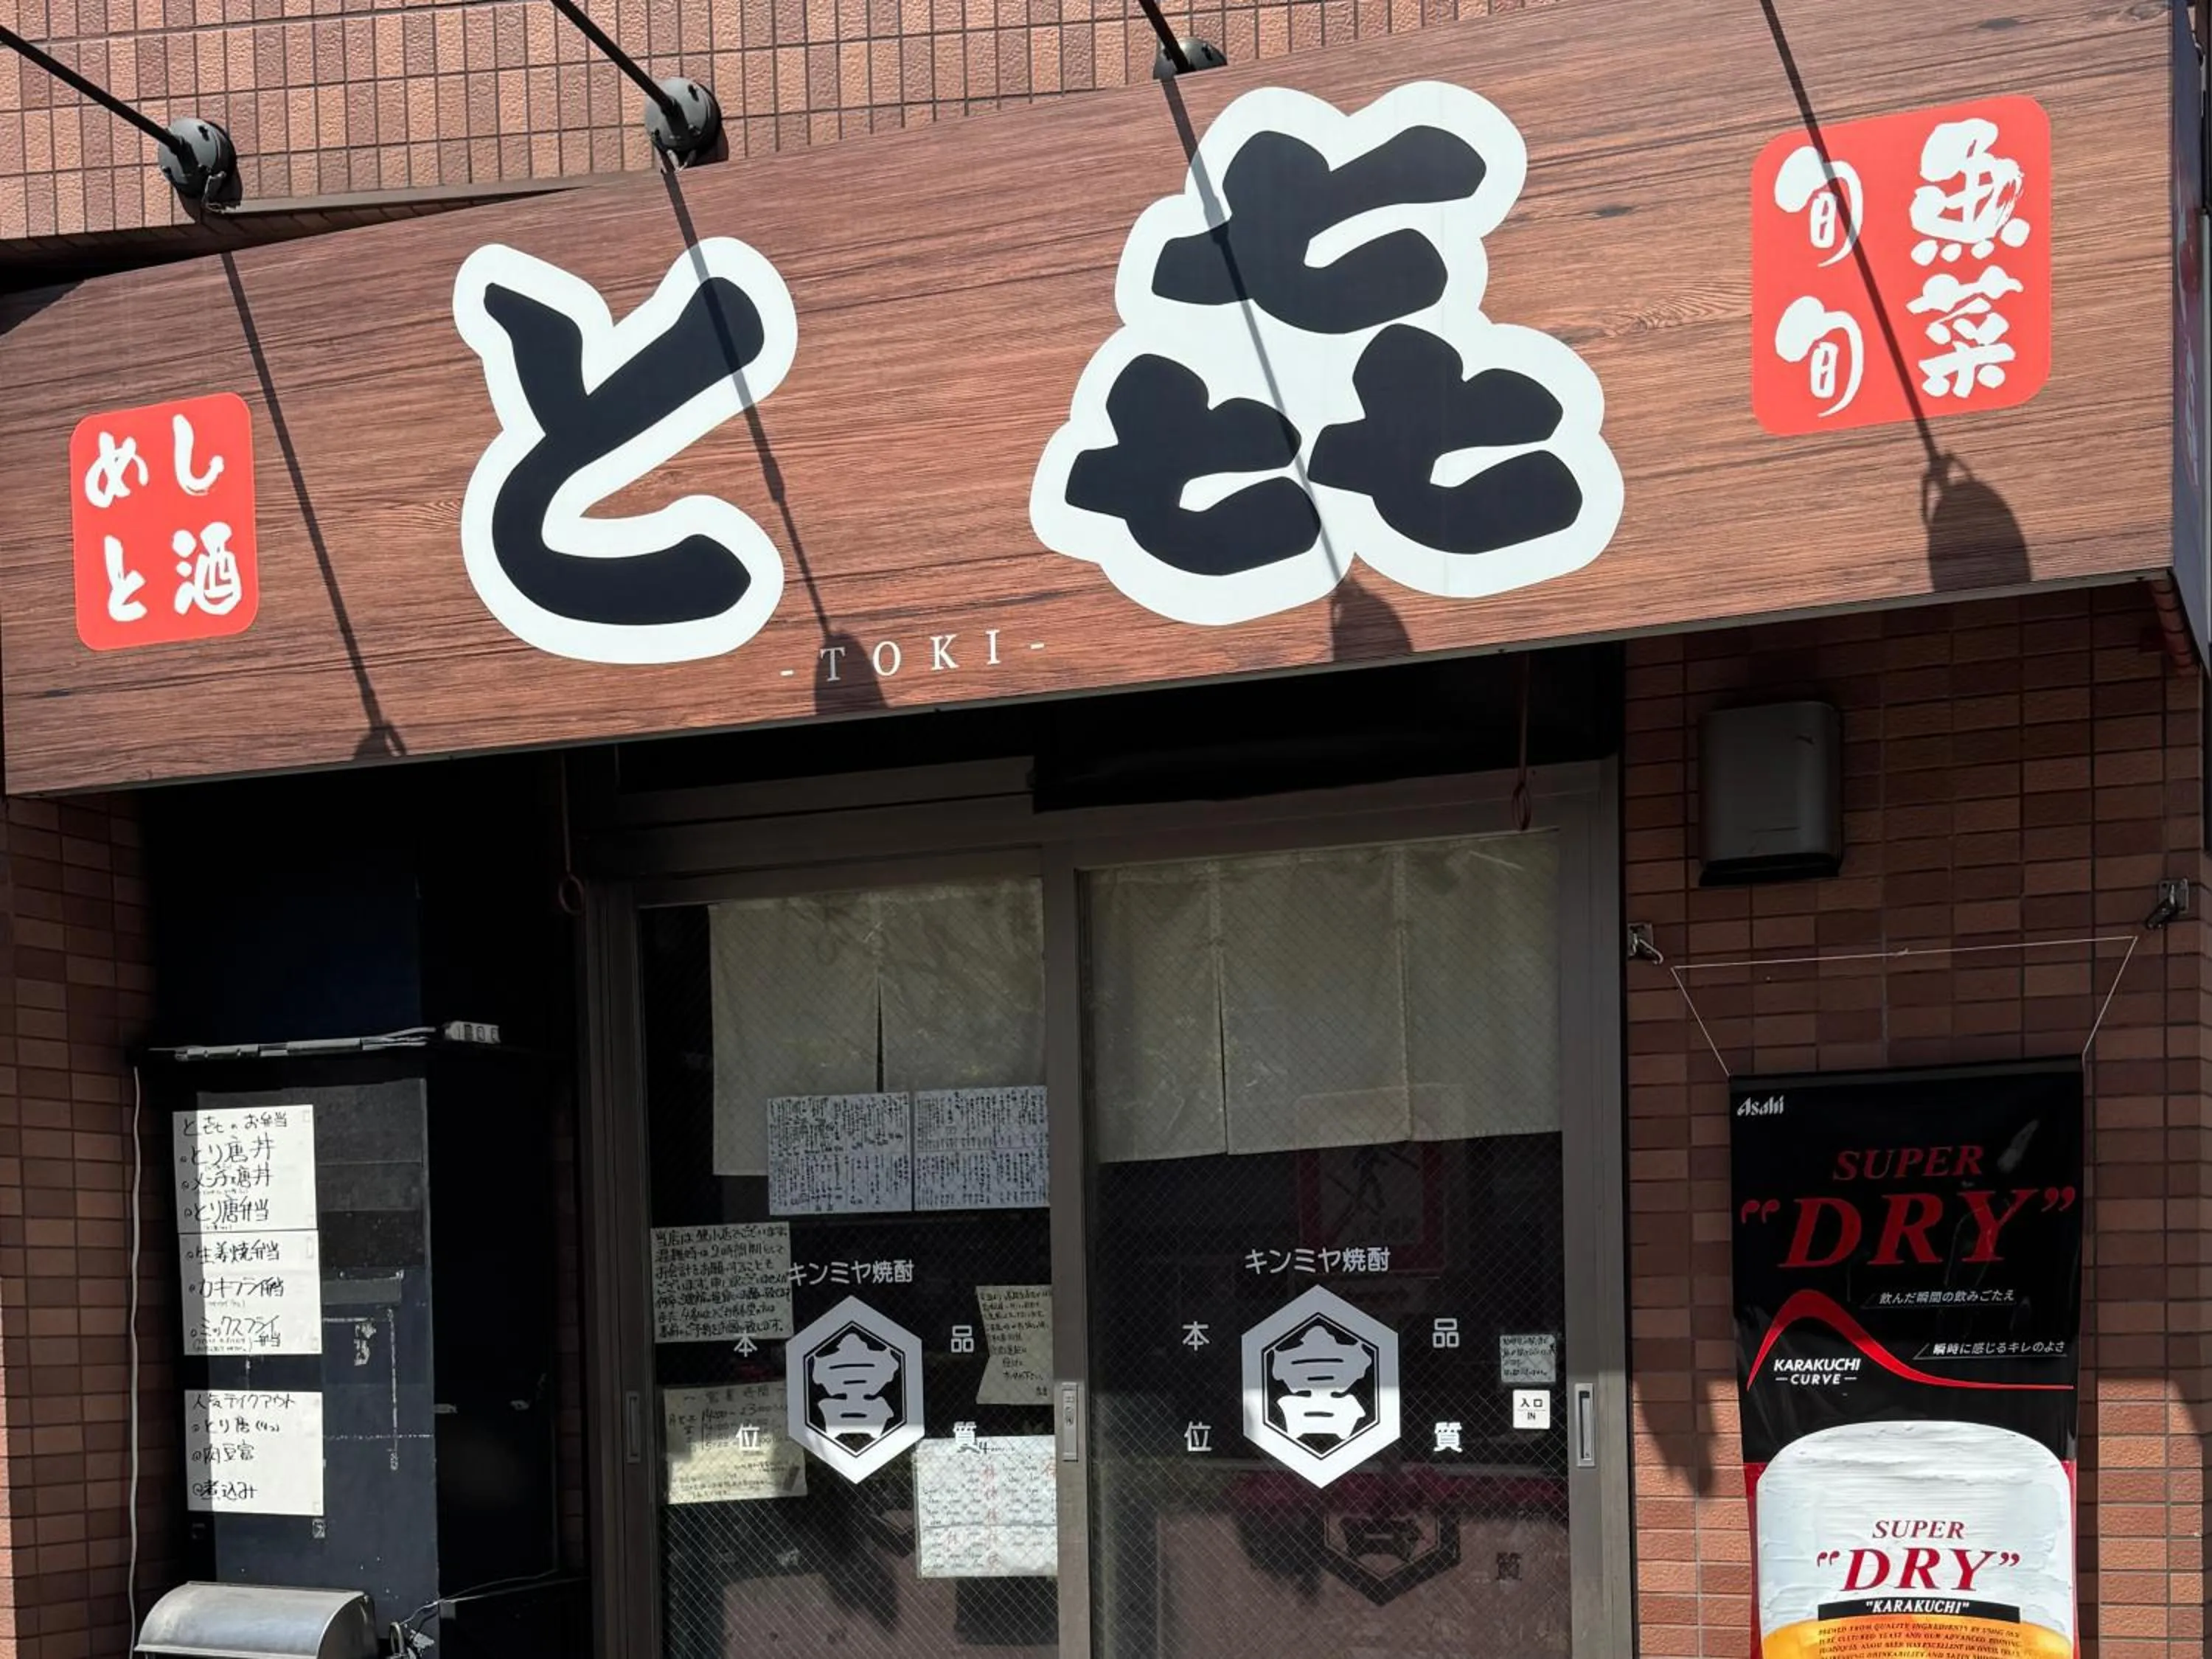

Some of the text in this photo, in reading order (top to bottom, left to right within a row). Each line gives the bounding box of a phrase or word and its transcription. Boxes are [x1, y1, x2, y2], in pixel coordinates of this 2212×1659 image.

[1906, 118, 2031, 398] 魚菜
[85, 414, 225, 509] めし
[103, 521, 243, 623] と酒
[1736, 1095, 1785, 1116] Asahi
[1833, 1144, 1985, 1181] SUPER
[1245, 1246, 1391, 1276] キンミヤ焼酎
[788, 1259, 914, 1284] キンミヤ焼酎
[1879, 1290, 2015, 1305] 飲んだ瞬間の飲みごたえ
[1933, 1340, 2065, 1355] 瞬時に感じるキレのよさ
[1773, 1357, 1861, 1372] KARAKUCHI
[1790, 1374, 1841, 1386] CURVE
[1520, 1397, 1543, 1408] 入口
[1527, 1411, 1537, 1421] IN
[1872, 1520, 1965, 1540] SUPER
